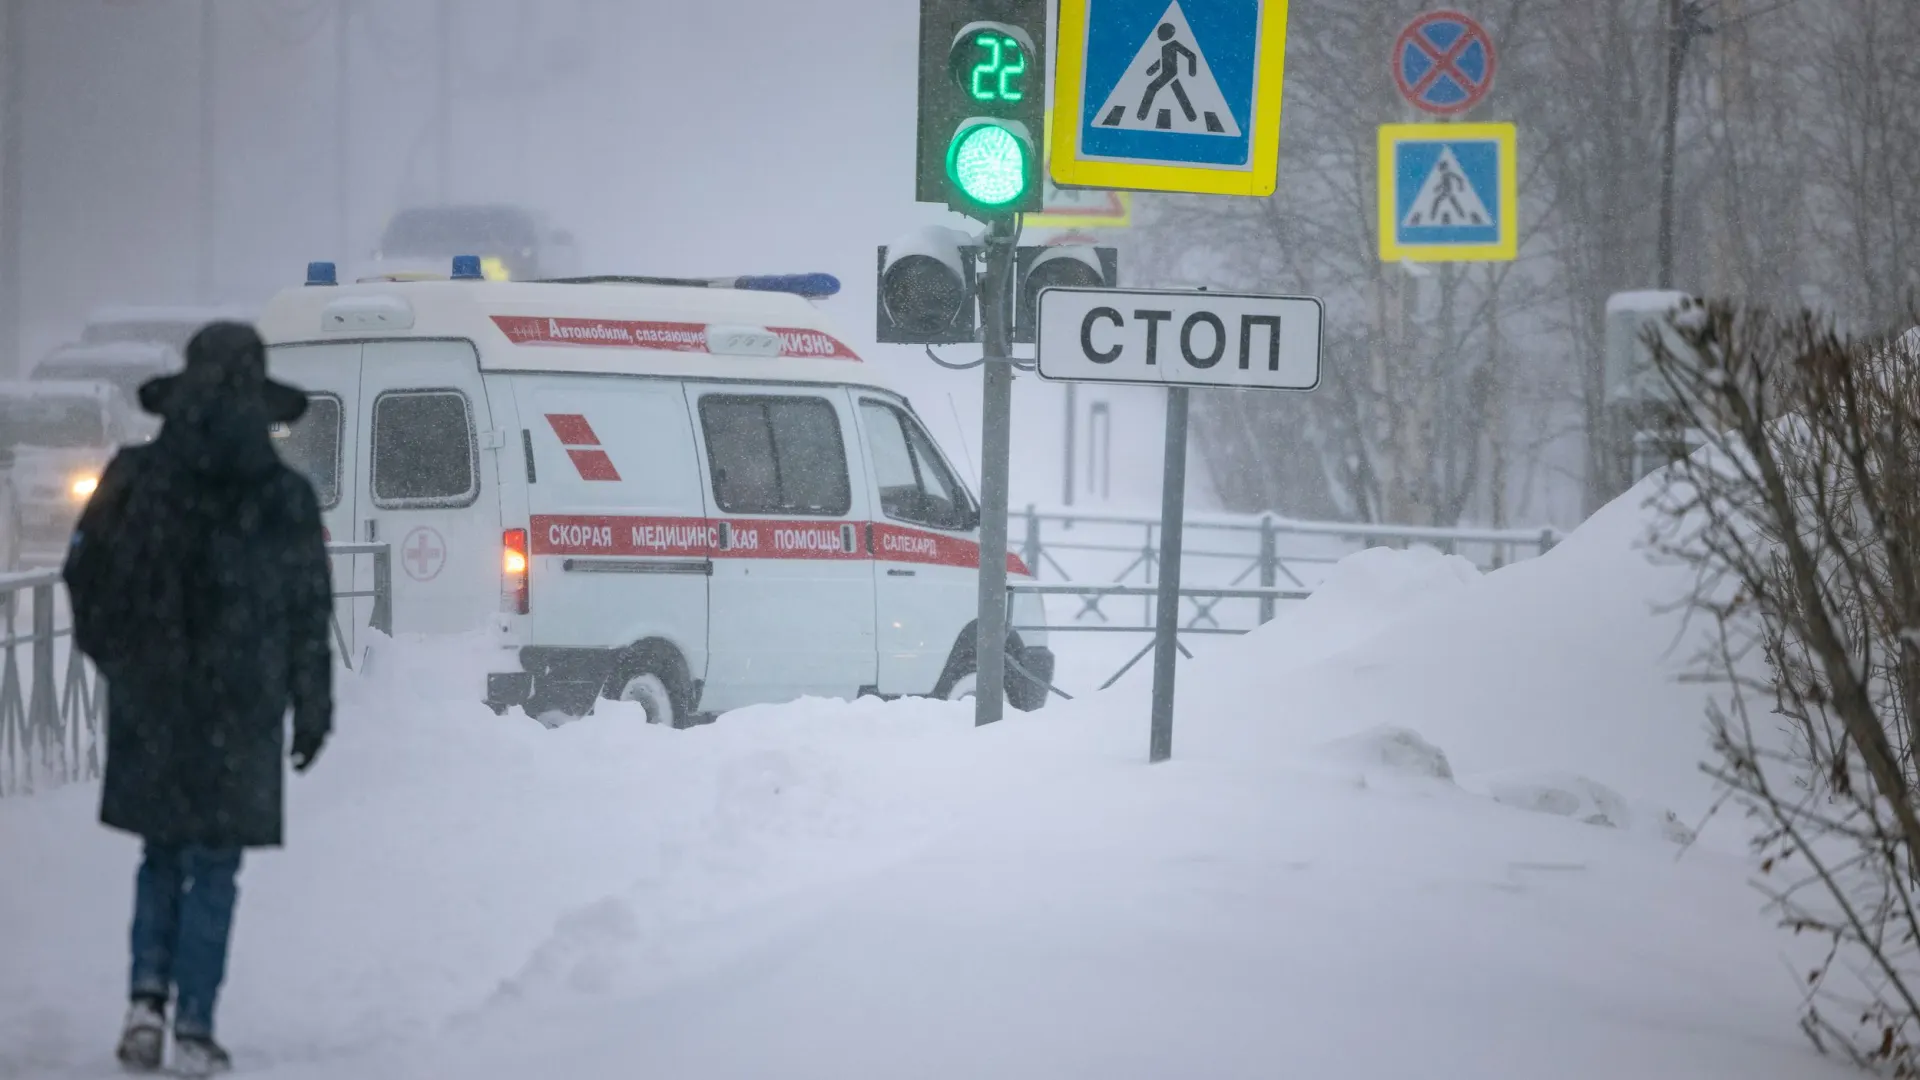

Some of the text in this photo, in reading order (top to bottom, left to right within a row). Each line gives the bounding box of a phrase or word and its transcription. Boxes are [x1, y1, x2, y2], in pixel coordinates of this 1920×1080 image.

[973, 36, 1025, 101] 22
[549, 318, 634, 343] Автомобили,
[635, 329, 705, 345] спасающие
[1080, 306, 1282, 371] СТОП
[549, 524, 612, 547] СКОРАЯ
[774, 529, 841, 553] ПОМОЩЬ
[883, 533, 936, 557] САЛЕХАРД
